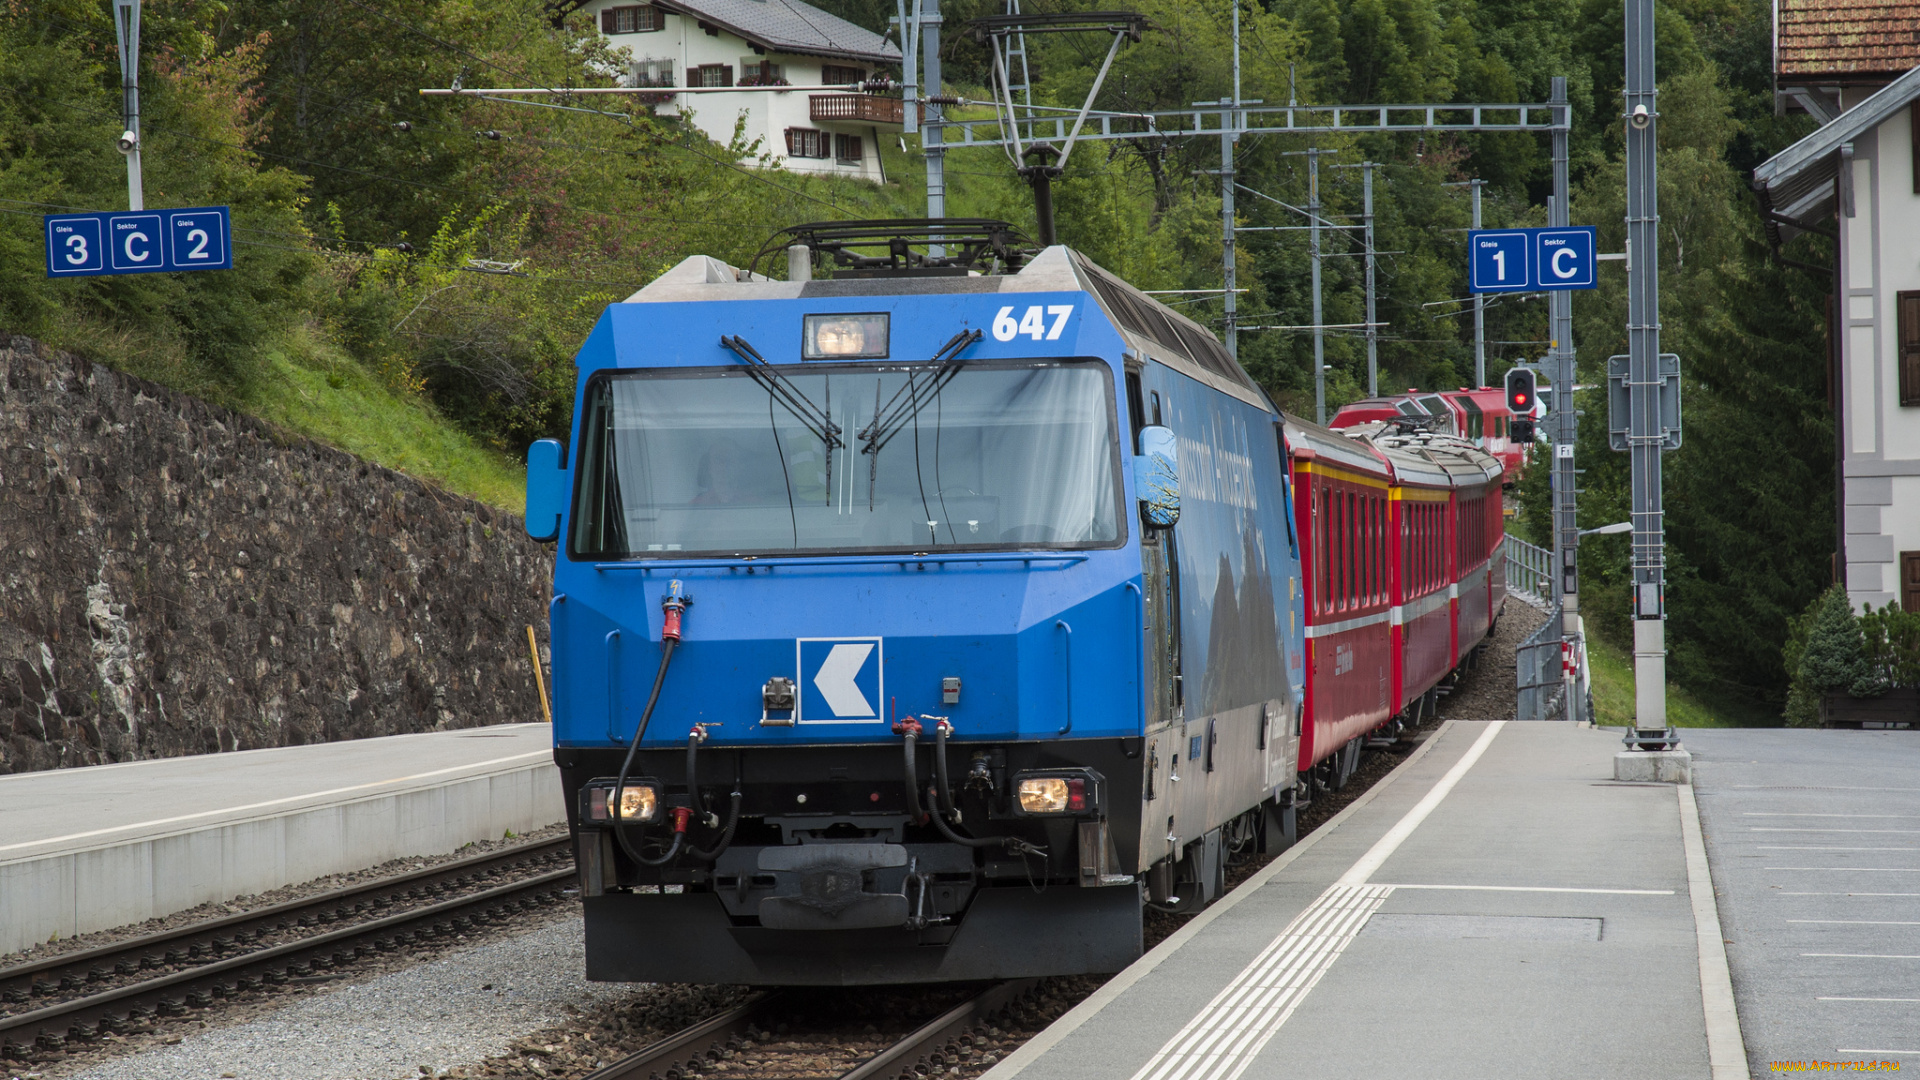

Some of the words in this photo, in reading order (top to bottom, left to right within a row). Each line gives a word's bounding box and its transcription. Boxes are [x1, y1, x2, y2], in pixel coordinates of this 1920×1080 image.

[65, 235, 88, 265] 3
[124, 231, 150, 262] C
[187, 229, 209, 259] 2
[1492, 250, 1505, 281] 1
[1552, 248, 1578, 279] C
[992, 305, 1075, 342] 647
[1560, 447, 1570, 456] F1
